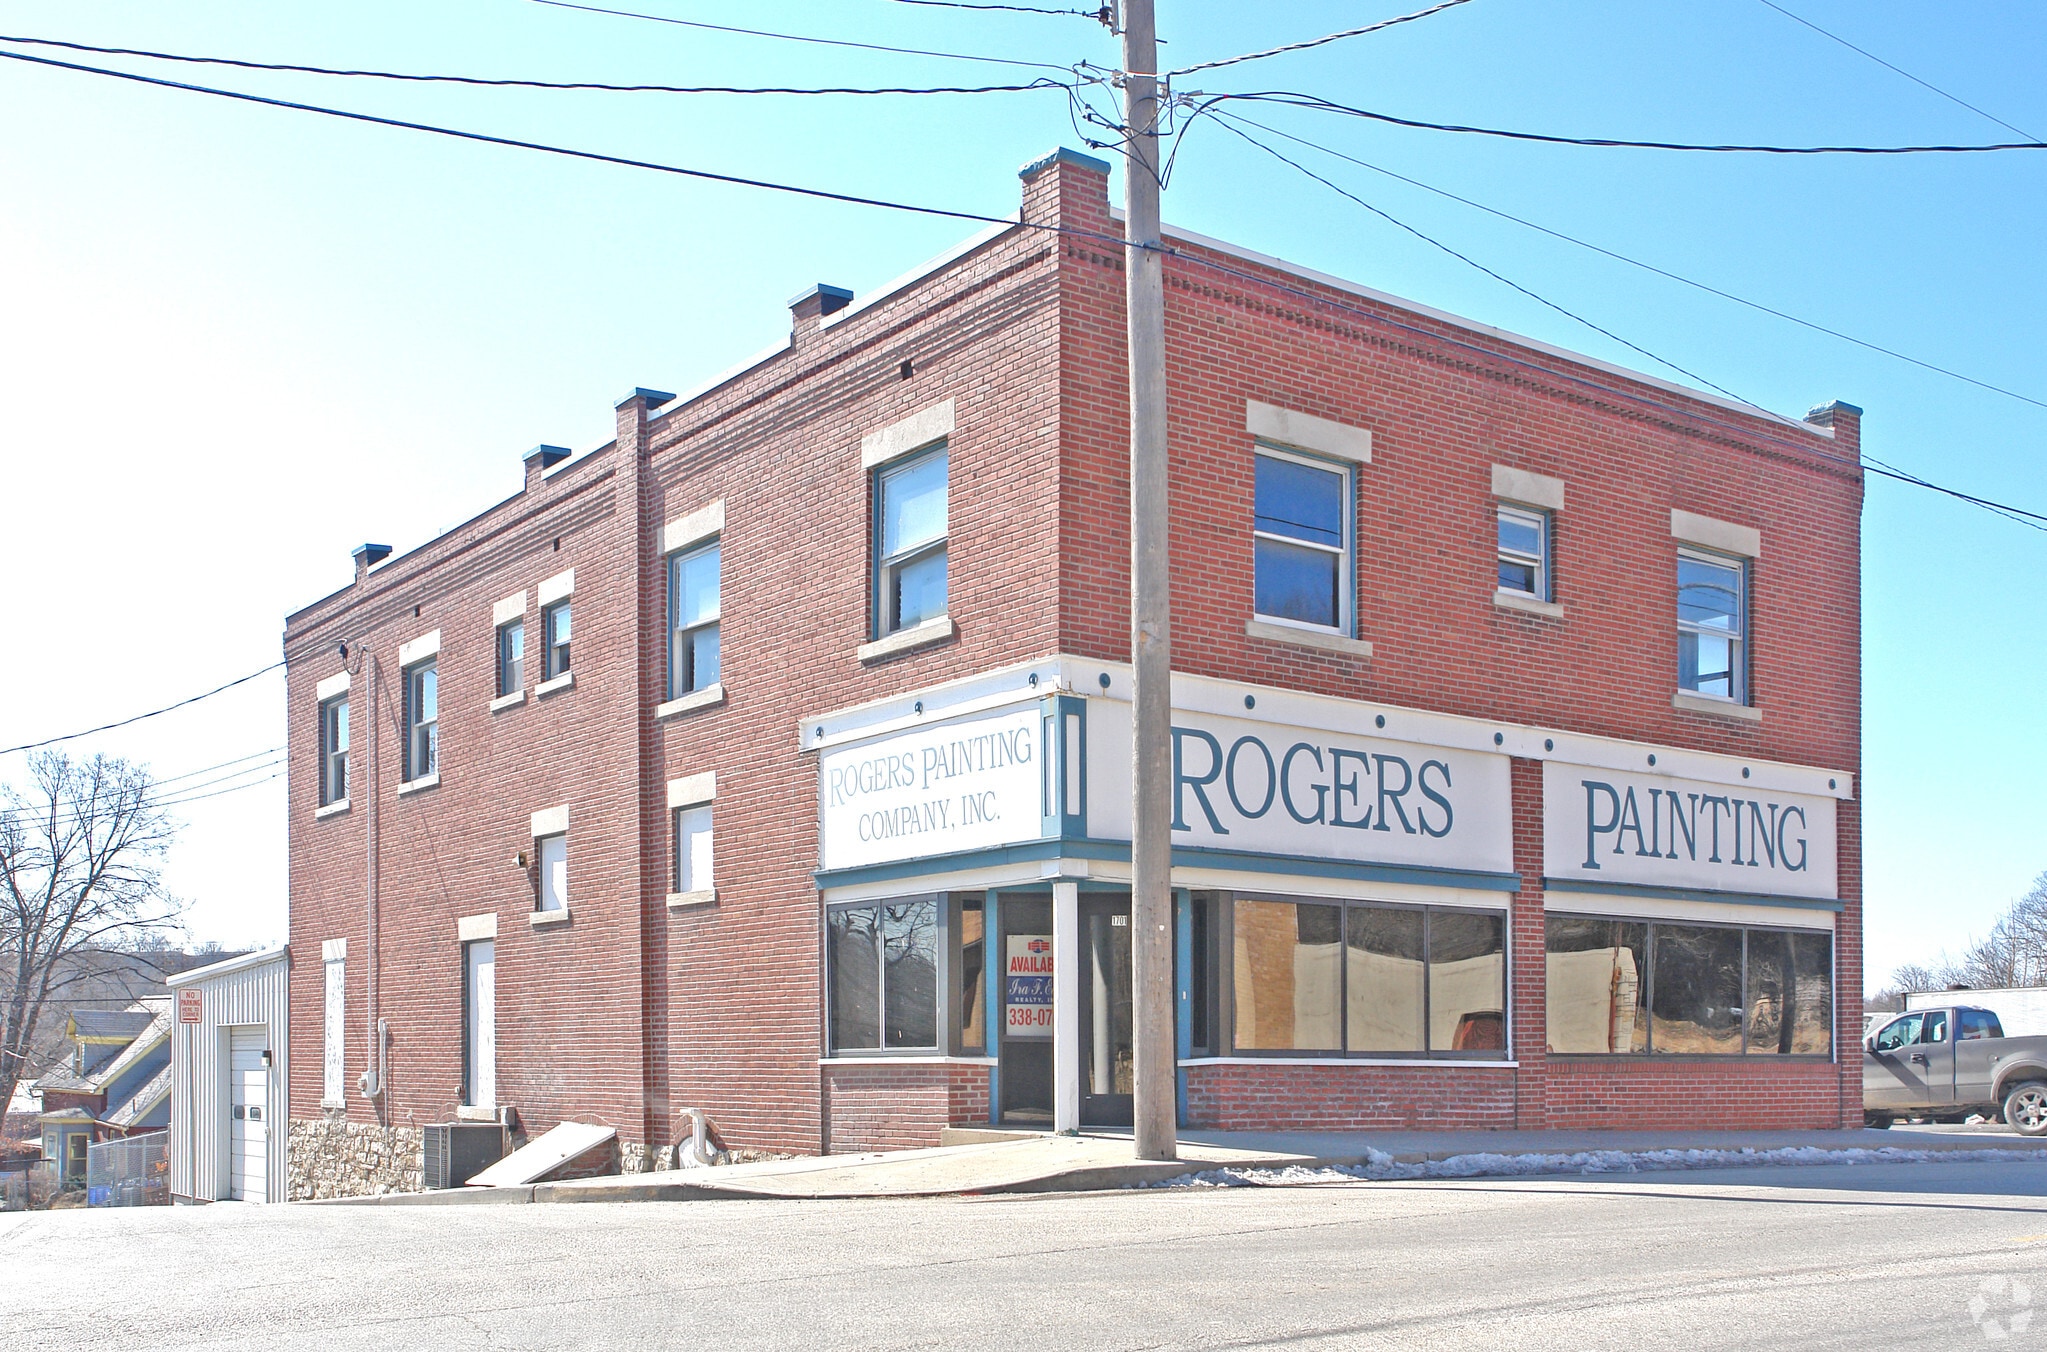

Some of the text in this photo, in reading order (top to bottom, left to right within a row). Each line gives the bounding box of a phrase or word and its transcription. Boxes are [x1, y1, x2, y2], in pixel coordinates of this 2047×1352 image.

[829, 727, 1032, 808] ROGERS PAINTING
[1171, 726, 1454, 838] ROGERS
[858, 791, 1000, 842] COMPANY, INC.
[1581, 780, 1807, 872] PAINTING
[1112, 916, 1127, 926] 1701
[1010, 956, 1053, 973] AVAILAB
[1009, 1008, 1053, 1026] 338-07
